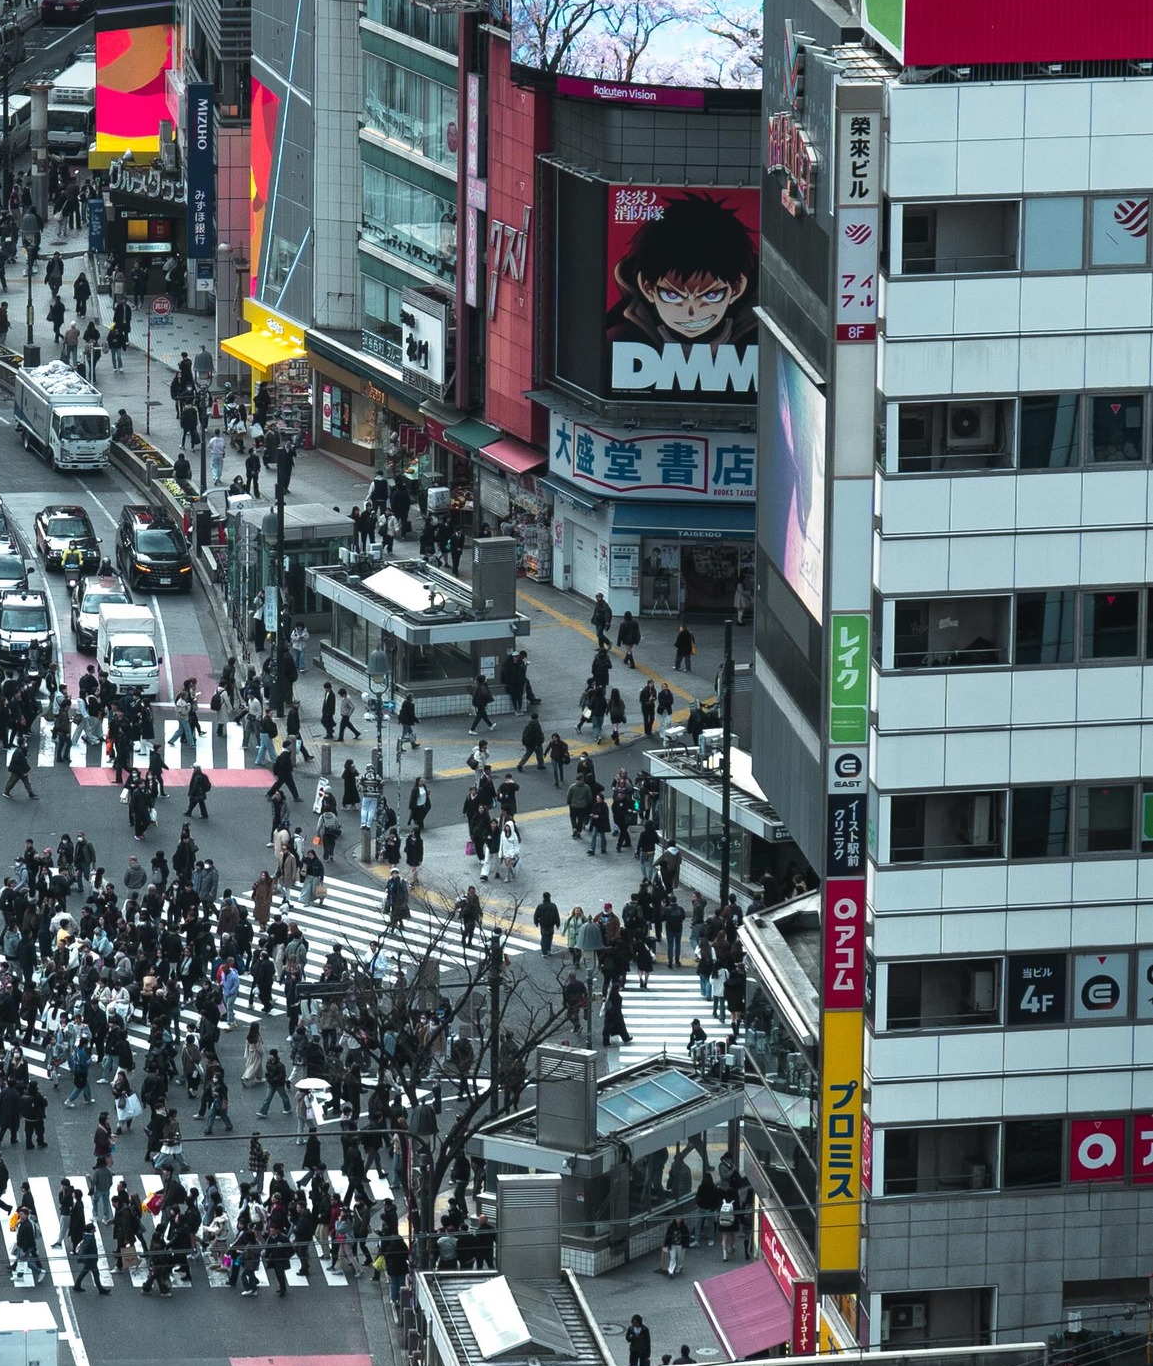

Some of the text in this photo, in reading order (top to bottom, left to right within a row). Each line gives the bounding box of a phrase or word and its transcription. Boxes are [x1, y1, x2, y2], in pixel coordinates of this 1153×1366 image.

[593, 85, 657, 101] Rakuten Vision
[196, 97, 209, 151] MIZUHO
[108, 158, 187, 204] グルメタウン
[615, 190, 657, 206] 炎炎ノ
[194, 189, 207, 247] みずほ銀行
[614, 205, 665, 222] 消防隊
[848, 326, 865, 339] 8F
[612, 342, 758, 392] DMM
[556, 427, 756, 486] 大盛堂書店
[677, 530, 722, 538] TAISEIDO
[837, 626, 860, 691] レイク
[834, 780, 862, 788] EAST
[834, 808, 846, 861] クリニック
[847, 799, 860, 868] イースト駅前
[833, 925, 857, 991] アコム
[1022, 967, 1053, 979] 当ビル
[1020, 984, 1054, 1013] 4F
[827, 1079, 858, 1200] プロミス
